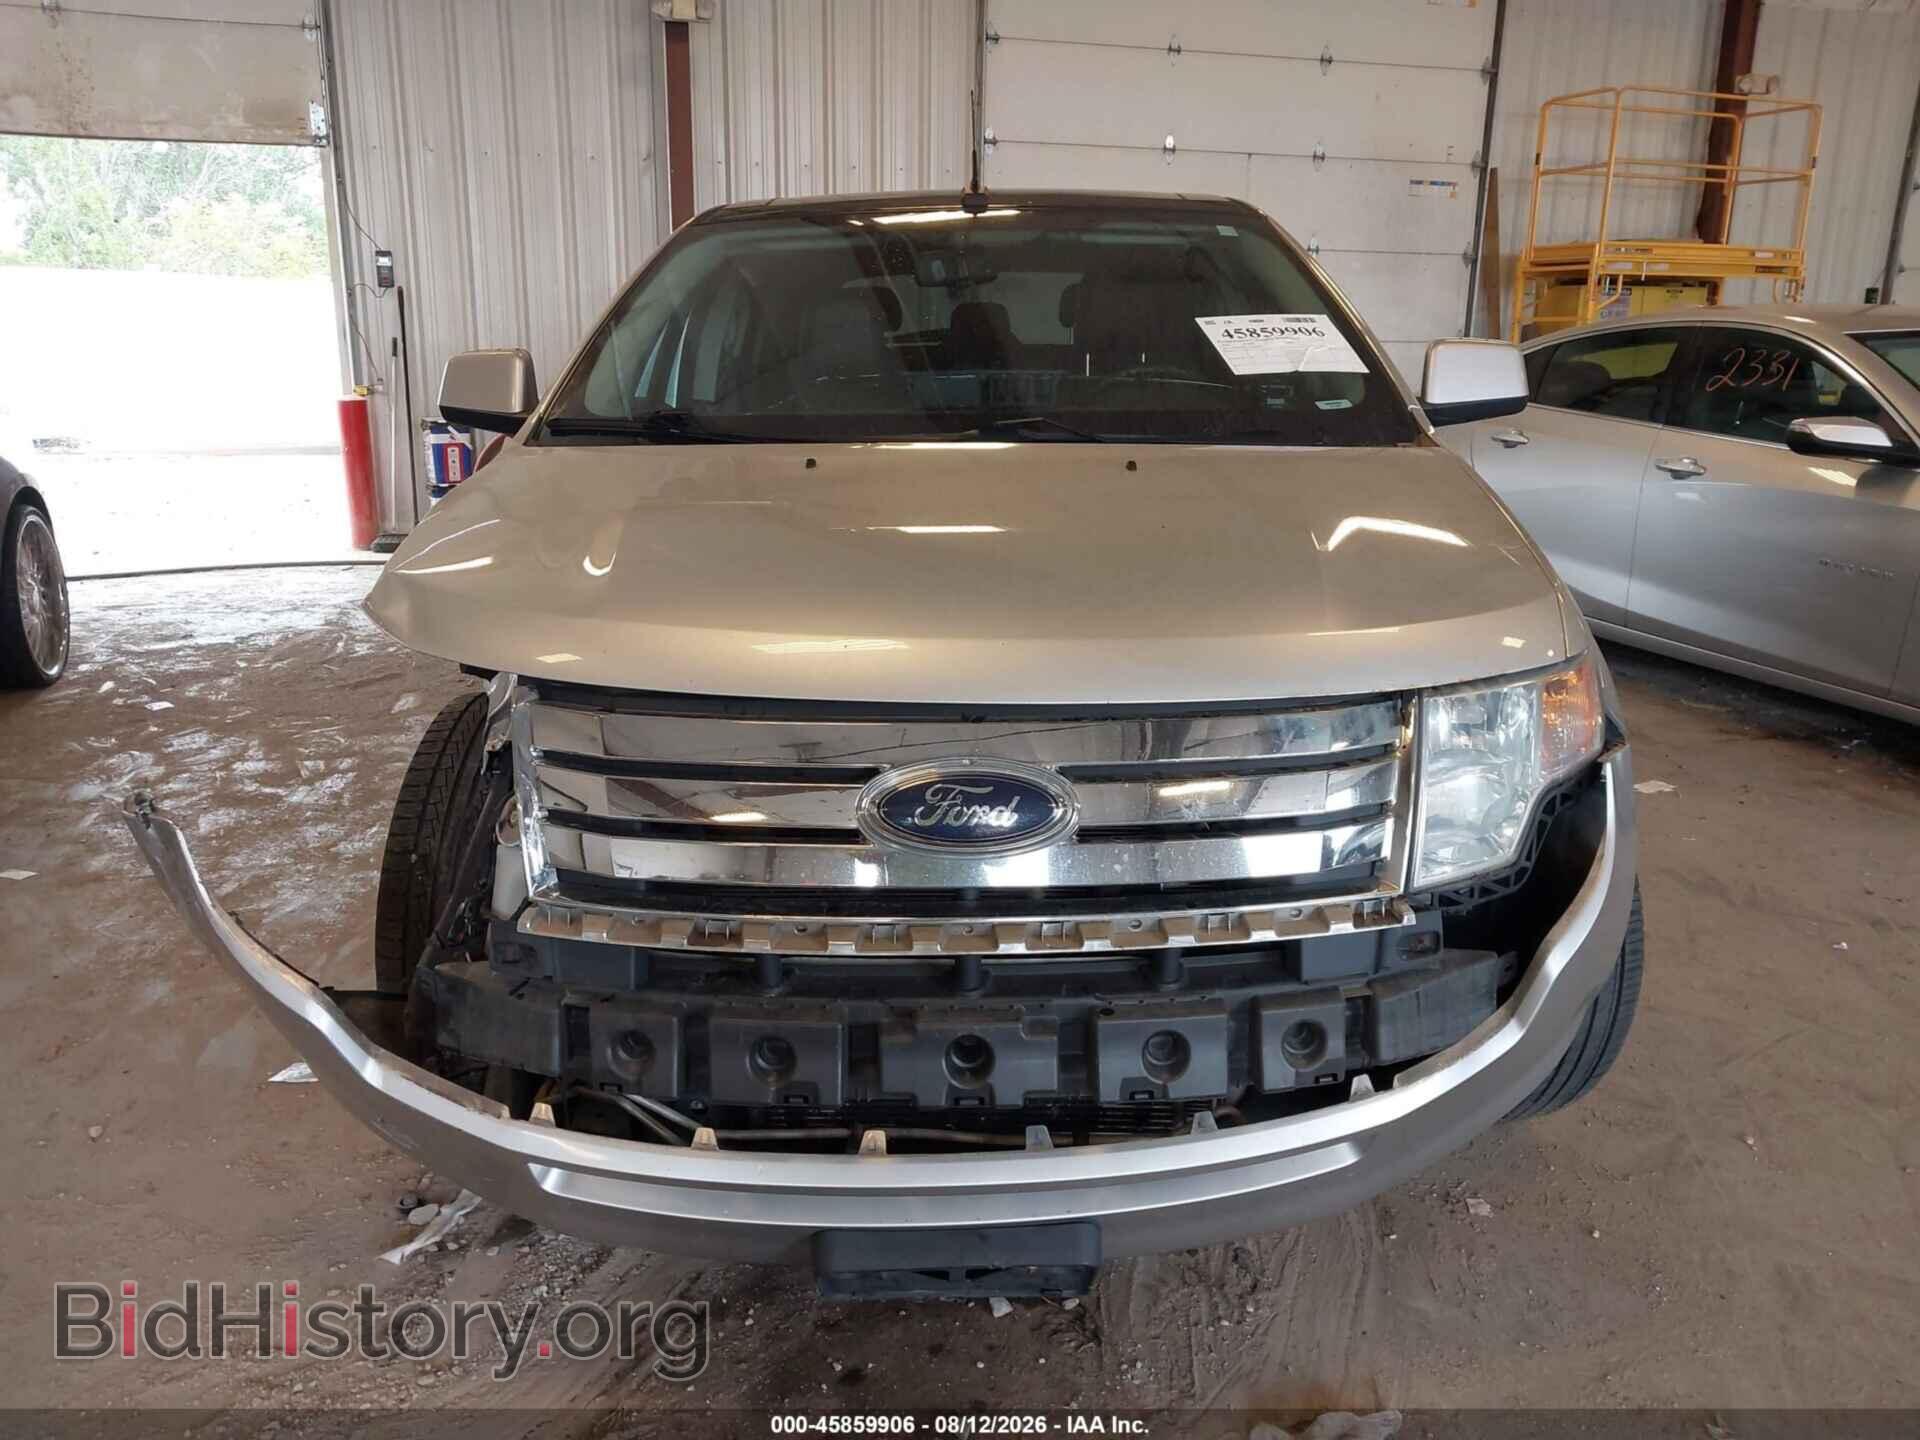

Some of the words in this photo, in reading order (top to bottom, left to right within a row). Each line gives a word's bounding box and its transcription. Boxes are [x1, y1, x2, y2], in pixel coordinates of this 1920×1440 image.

[1221, 326, 1326, 339] 45859906
[1705, 347, 1799, 392] 2331
[914, 783, 1021, 828] Ford
